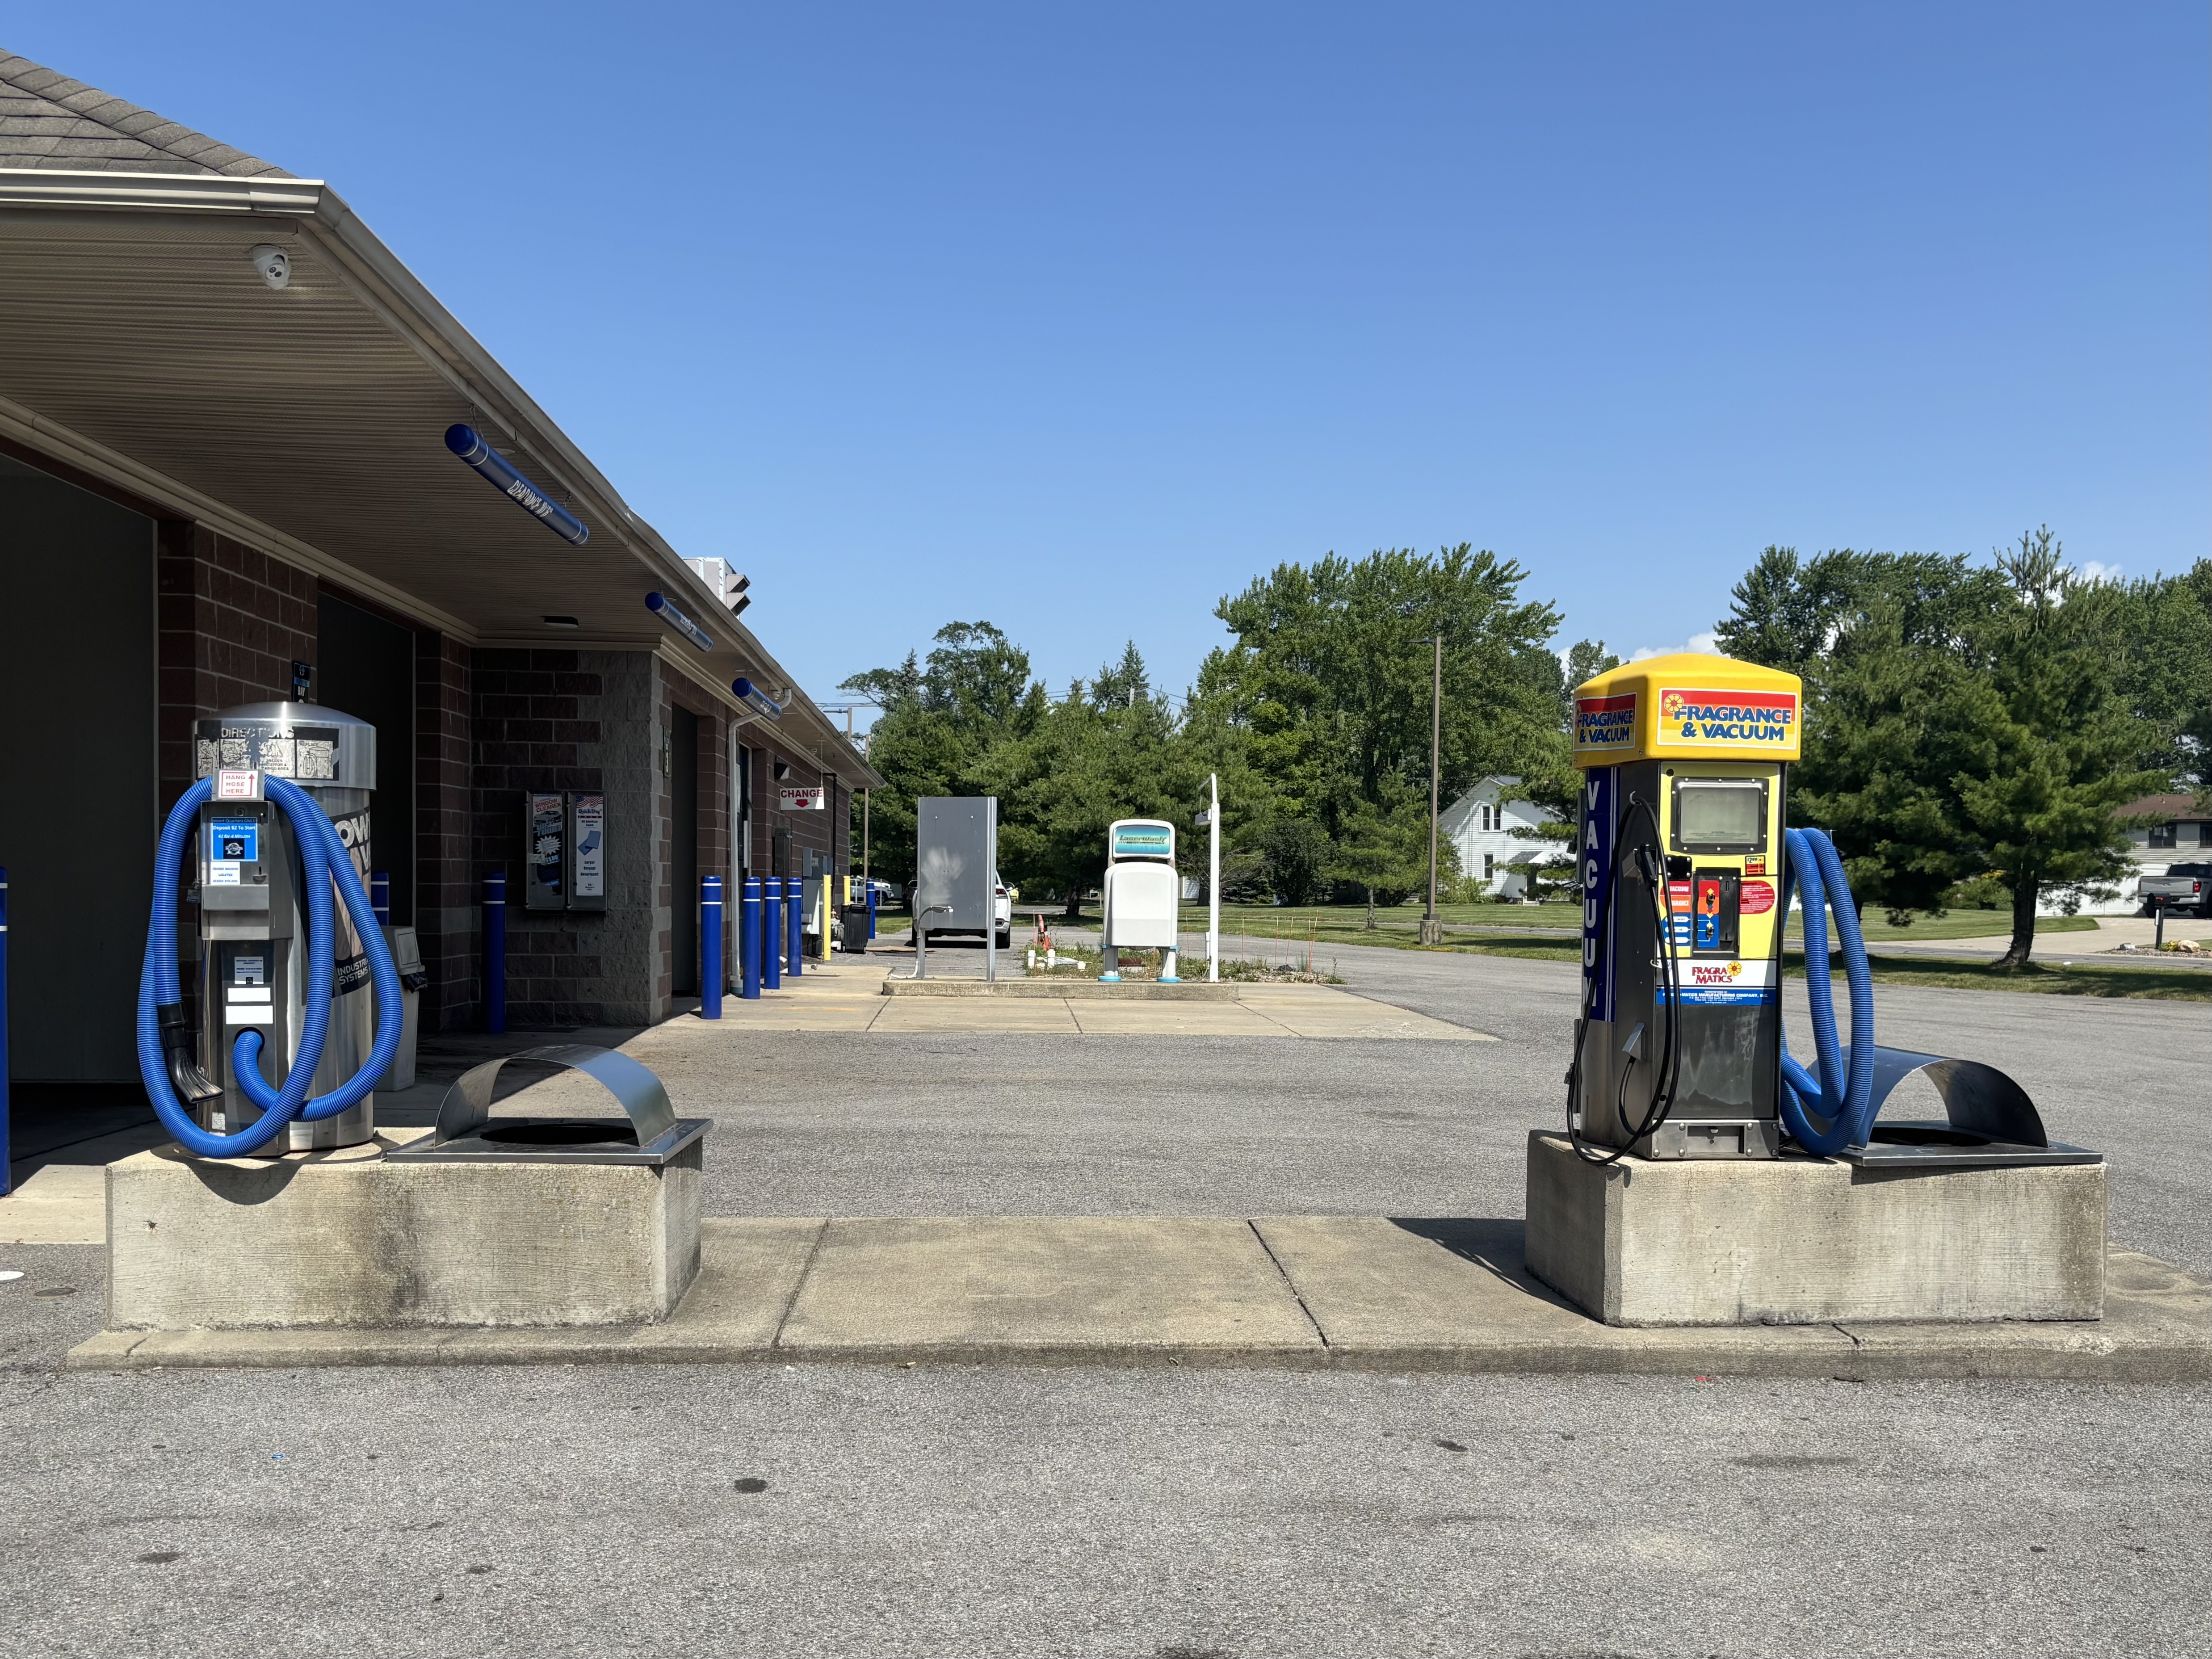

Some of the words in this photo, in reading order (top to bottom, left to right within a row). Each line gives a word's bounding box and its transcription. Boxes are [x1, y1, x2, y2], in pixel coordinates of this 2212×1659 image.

[1577, 710, 1633, 728] FRAGRANCE
[1674, 706, 1791, 724] FRAGRANCE
[1579, 729, 1586, 743] &
[1588, 727, 1629, 743] VACUUM
[1681, 722, 1697, 737] &
[1701, 723, 1784, 741] VACUUM
[535, 798, 557, 808] WINDOW
[537, 802, 561, 812] CLEANER
[1583, 781, 1600, 1007] VACUUM
[339, 966, 368, 985] SYSTEMS
[1692, 967, 1727, 976] FRAGRA
[1696, 975, 1732, 984] MATICS
